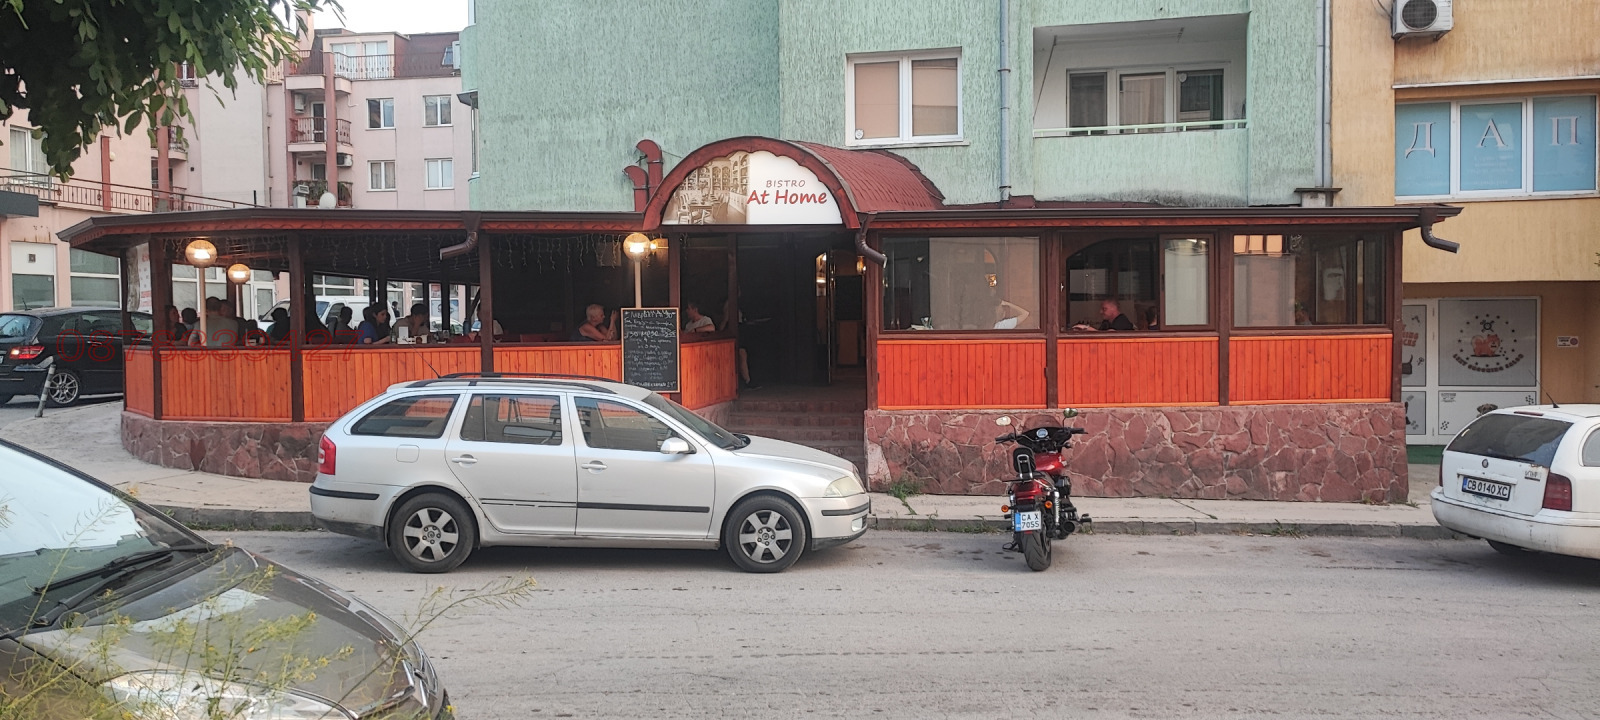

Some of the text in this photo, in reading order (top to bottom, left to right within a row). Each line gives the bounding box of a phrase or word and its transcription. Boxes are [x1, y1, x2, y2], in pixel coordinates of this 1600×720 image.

[766, 180, 806, 188] BISTRO
[747, 189, 827, 205] At Home
[1467, 480, 1508, 496] CB 0140 XC
